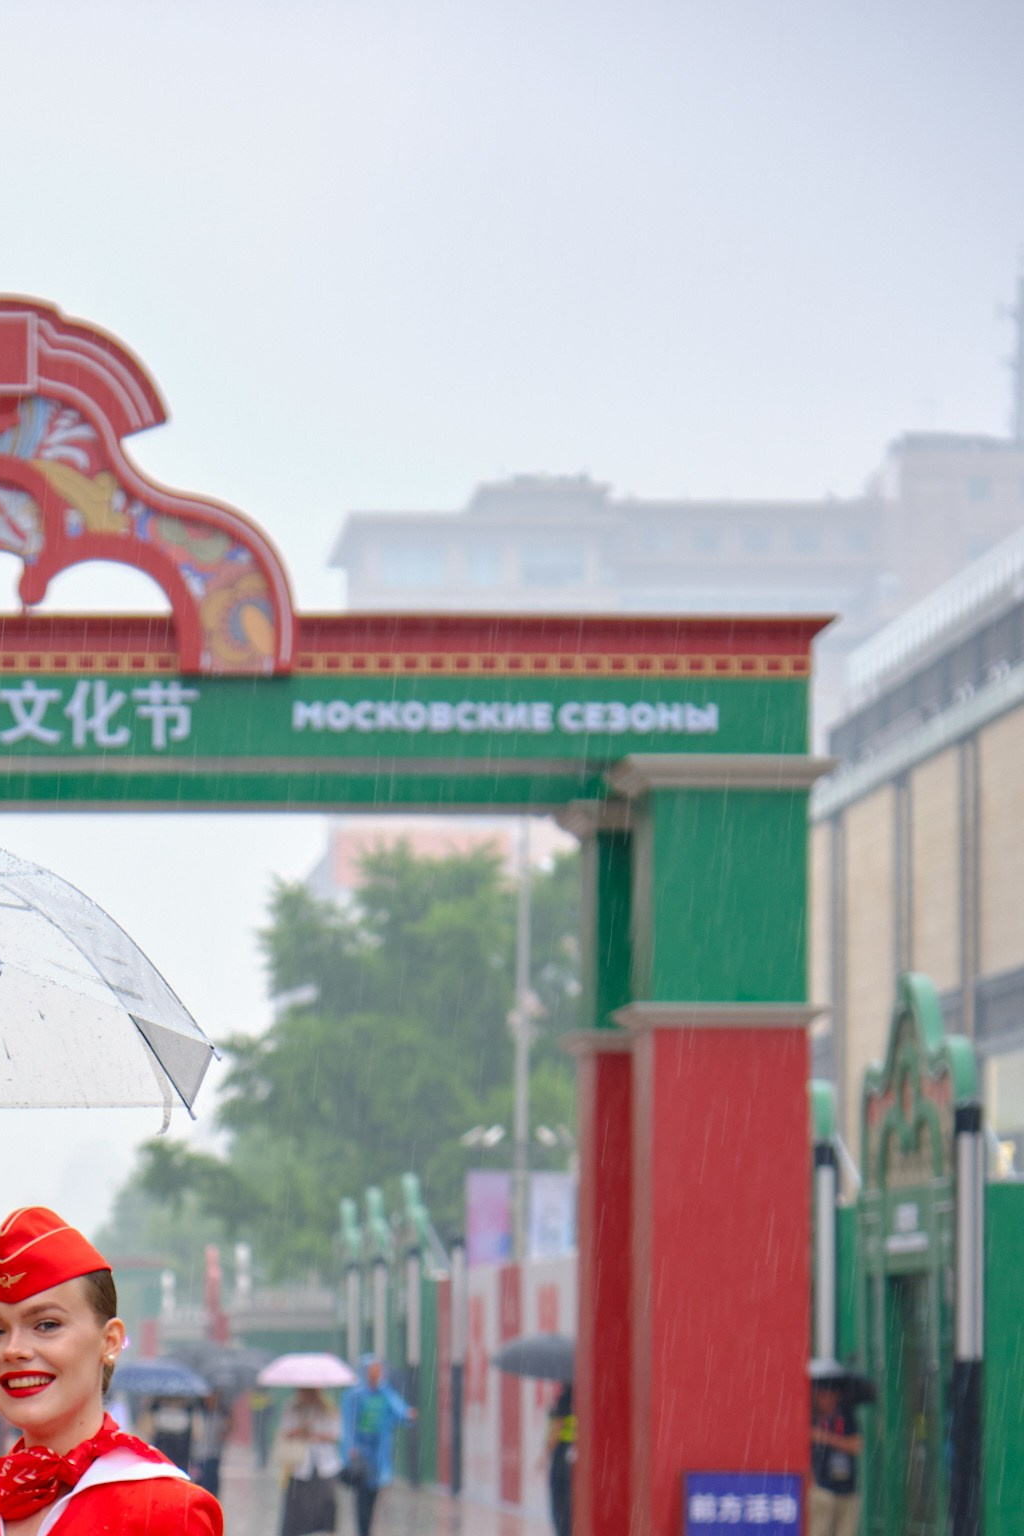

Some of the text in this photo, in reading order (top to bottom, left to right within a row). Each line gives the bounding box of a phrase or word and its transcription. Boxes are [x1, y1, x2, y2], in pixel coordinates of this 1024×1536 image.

[292, 700, 720, 734] МОСКОВСКИЕ СЕЗОНЫ
[690, 1493, 797, 1524] 前方活动
